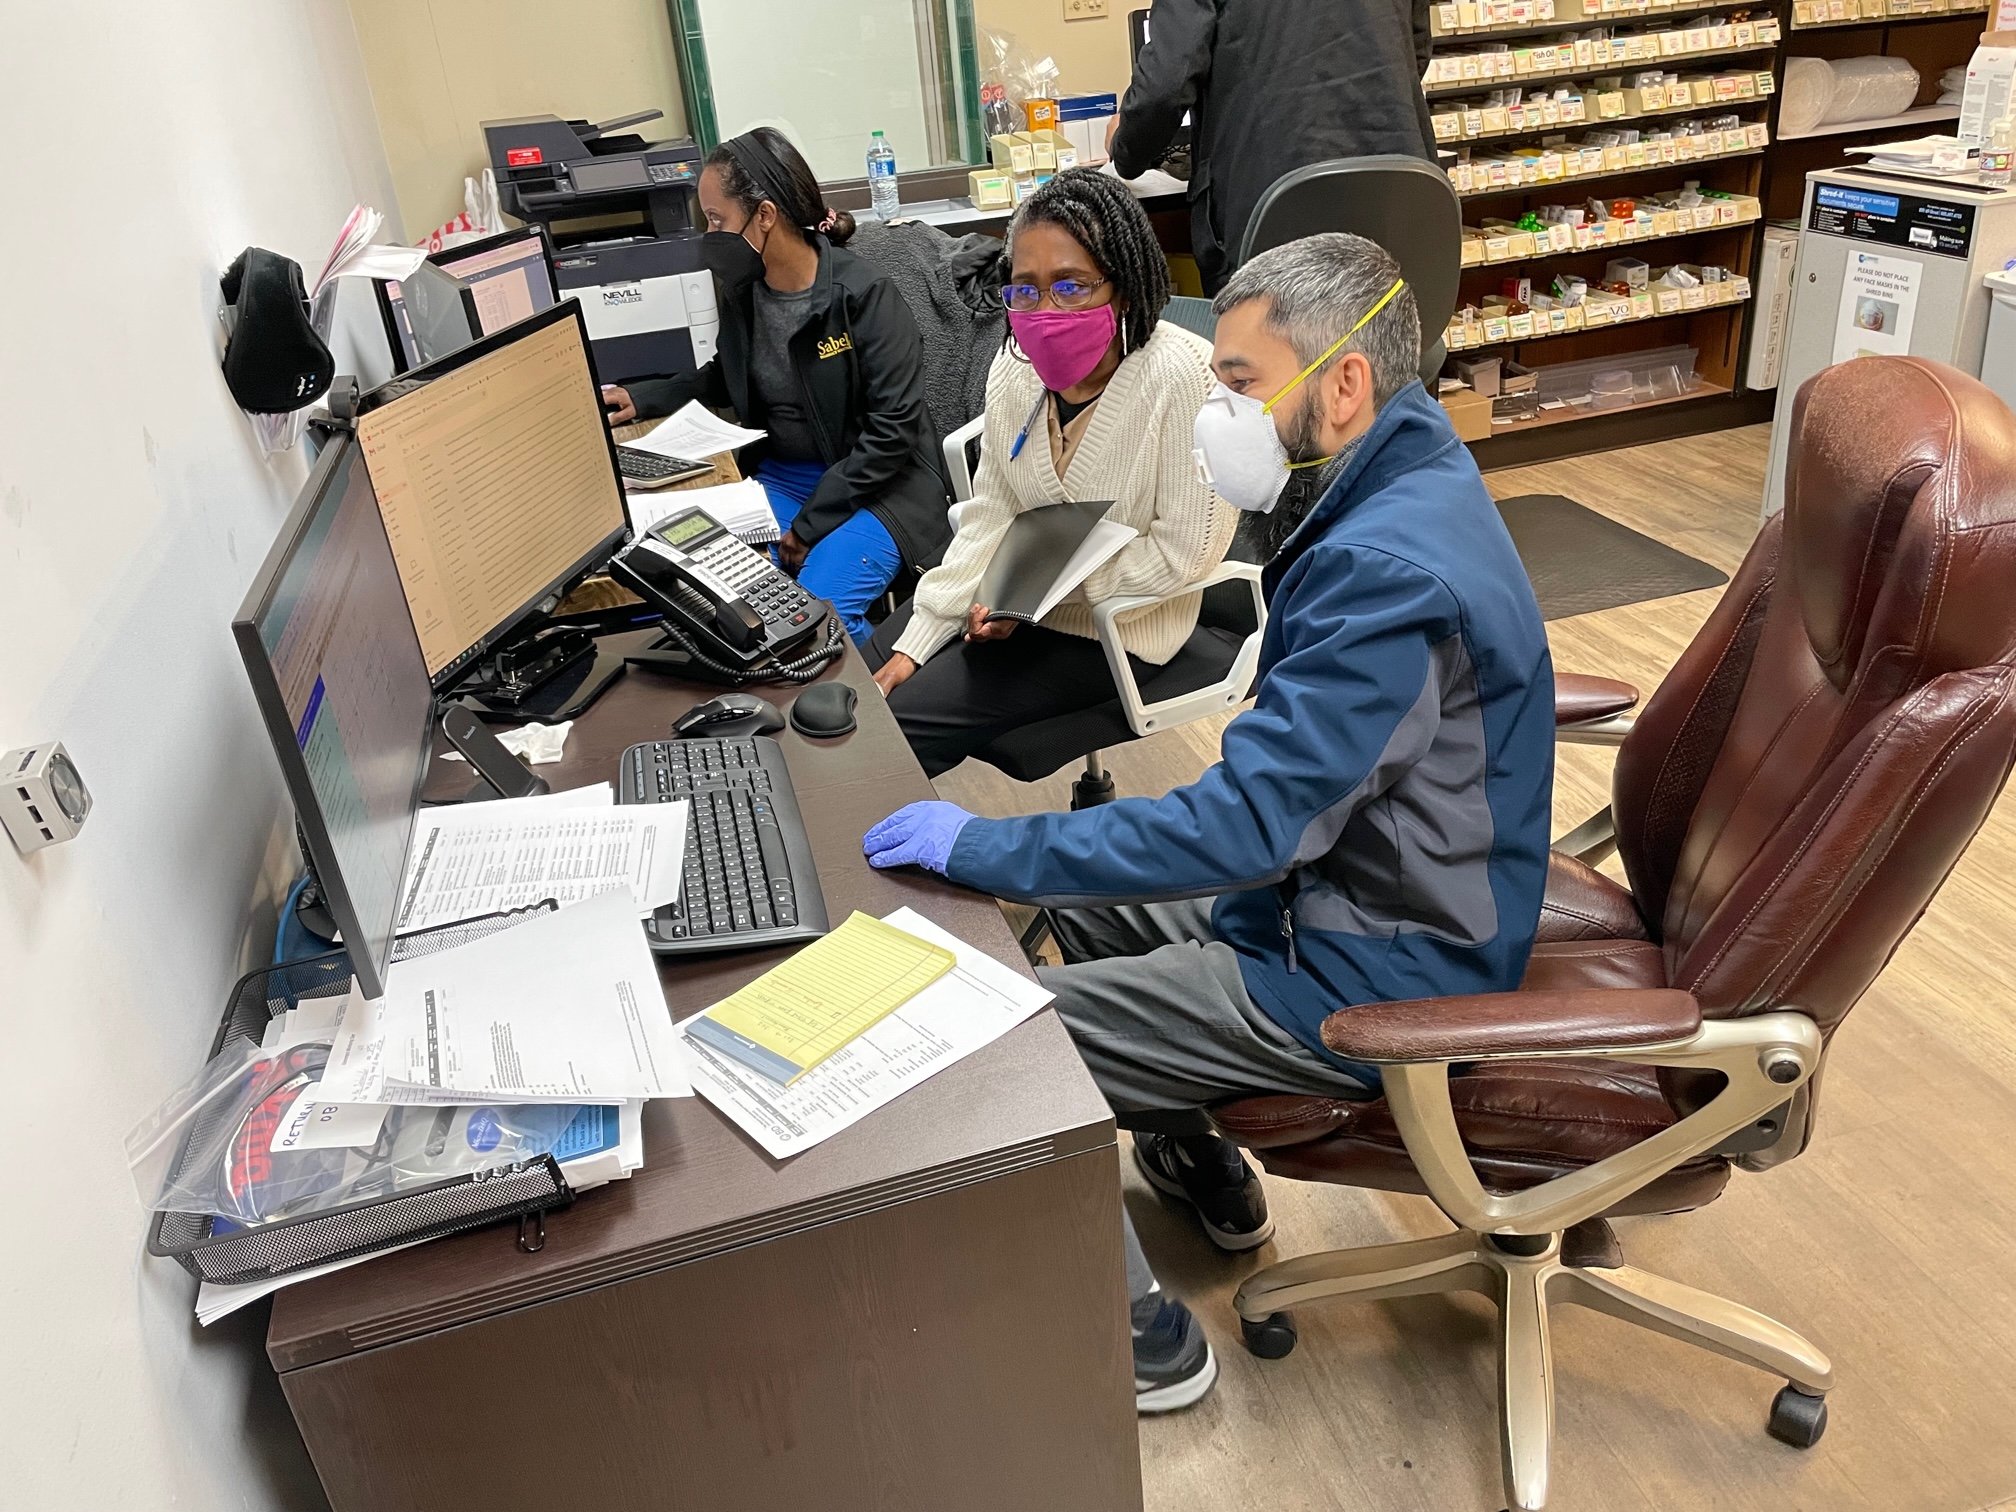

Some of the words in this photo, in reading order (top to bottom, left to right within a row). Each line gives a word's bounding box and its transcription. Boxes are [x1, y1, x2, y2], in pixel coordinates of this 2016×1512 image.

[1860, 196, 1872, 204] your
[1873, 197, 1896, 207] sensitive
[1857, 267, 1874, 276] PLEASE
[1894, 274, 1909, 282] PLACE
[1863, 278, 1876, 286] FACE
[1876, 280, 1893, 289] MASKS
[603, 289, 642, 299] NEVILL
[1865, 288, 1881, 296] SHRED
[1882, 291, 1893, 299] BINS
[604, 297, 643, 305] KNOWLEDGE
[282, 1101, 317, 1146] RETURN
[771, 1126, 785, 1136] BD
